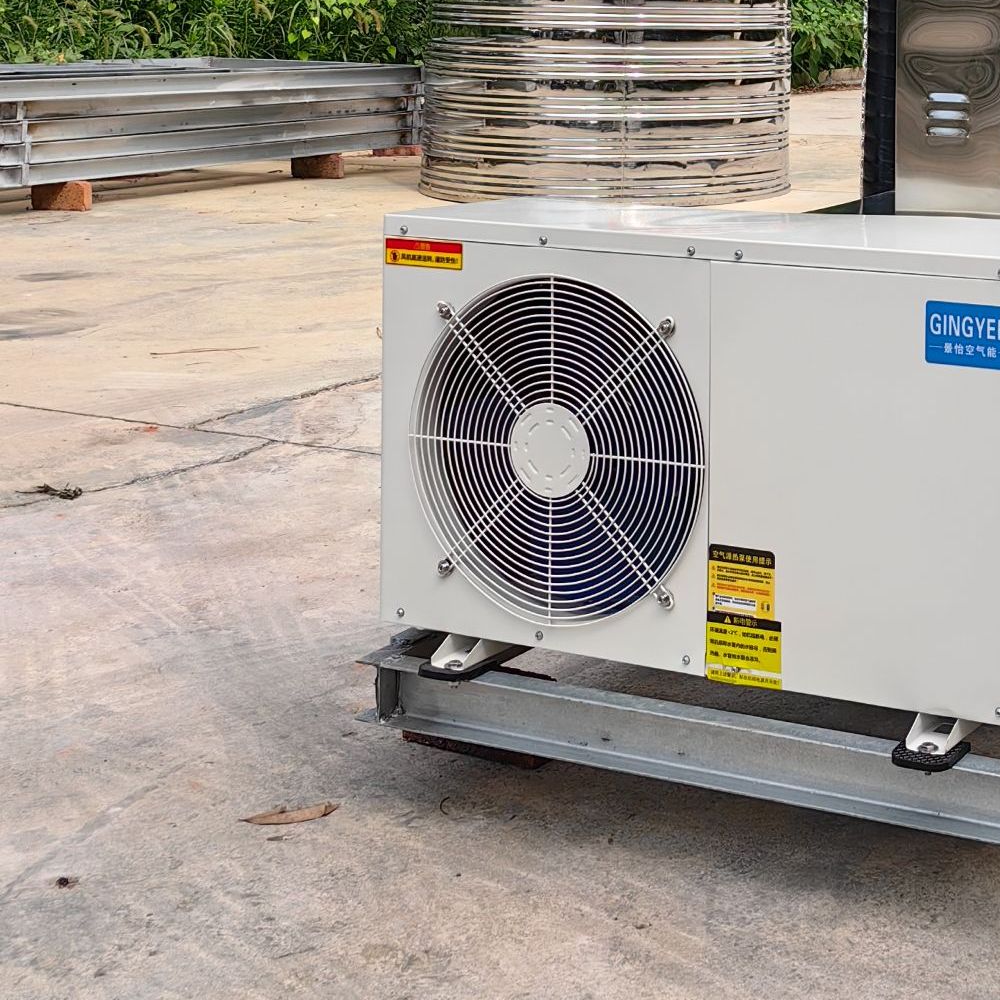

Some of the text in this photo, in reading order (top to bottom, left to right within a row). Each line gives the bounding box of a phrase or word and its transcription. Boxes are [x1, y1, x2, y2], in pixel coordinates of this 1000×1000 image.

[943, 342, 997, 359] 景怡空气能
